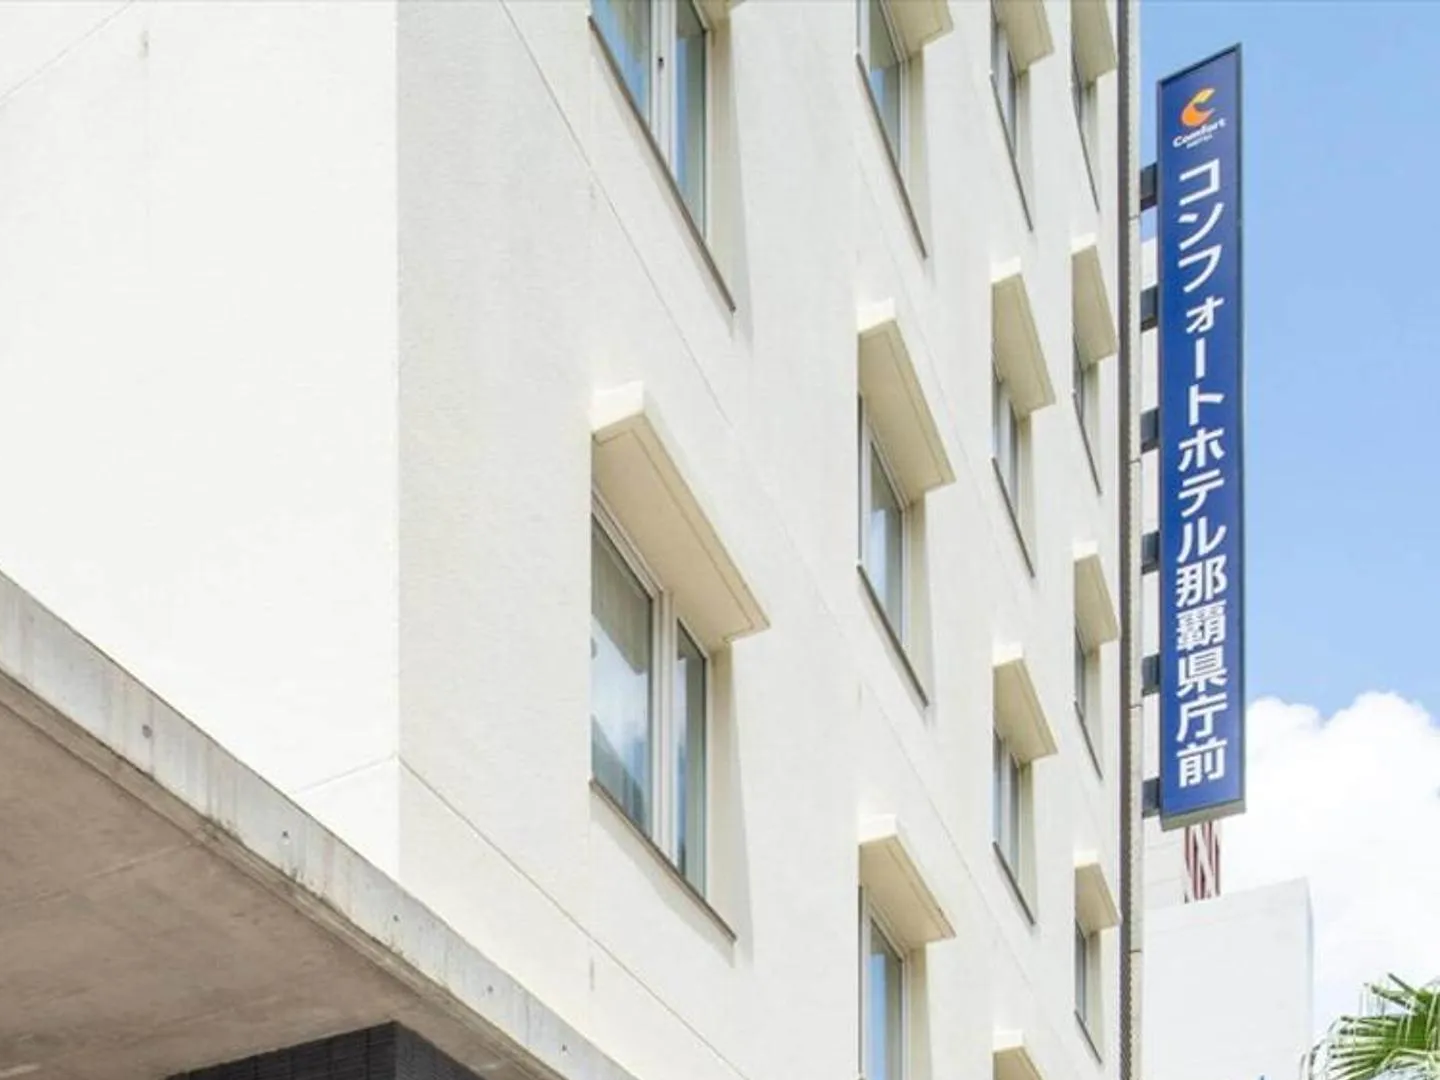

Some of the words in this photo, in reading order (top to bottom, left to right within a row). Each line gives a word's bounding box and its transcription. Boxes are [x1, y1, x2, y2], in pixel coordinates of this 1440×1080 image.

[1176, 158, 1228, 787] コンフォートホテル那覇県庁前
